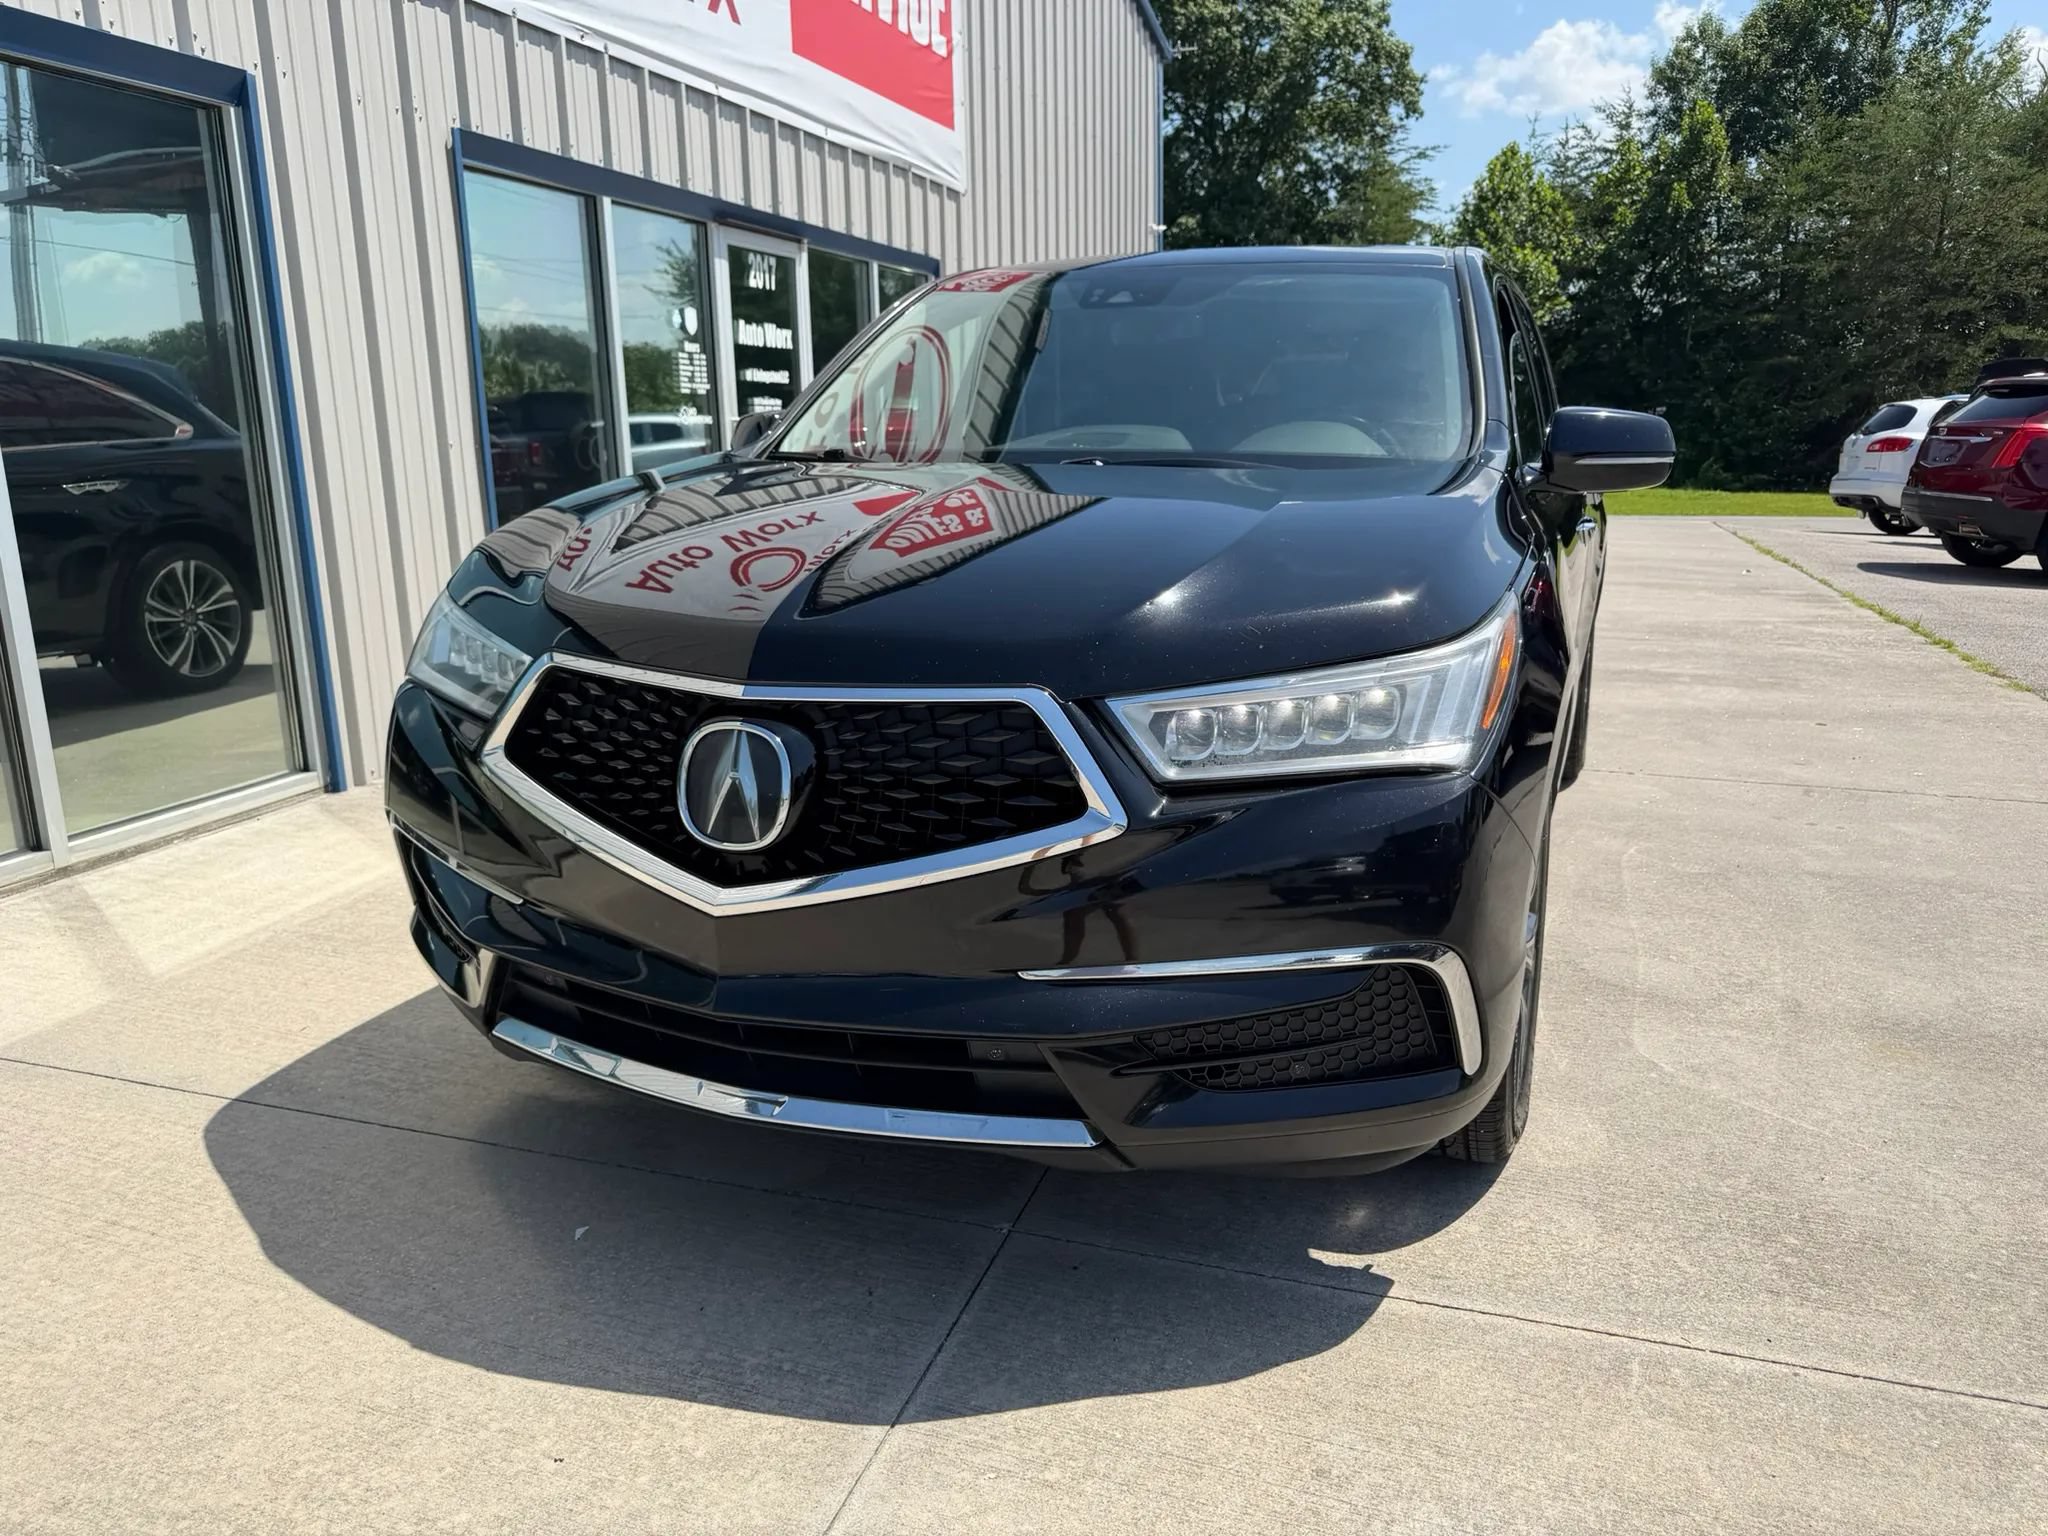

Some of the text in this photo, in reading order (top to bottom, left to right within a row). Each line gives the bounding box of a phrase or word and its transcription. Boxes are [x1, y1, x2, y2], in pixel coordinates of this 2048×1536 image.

[748, 252, 777, 291] 2017
[738, 319, 793, 350] Auto Worx
